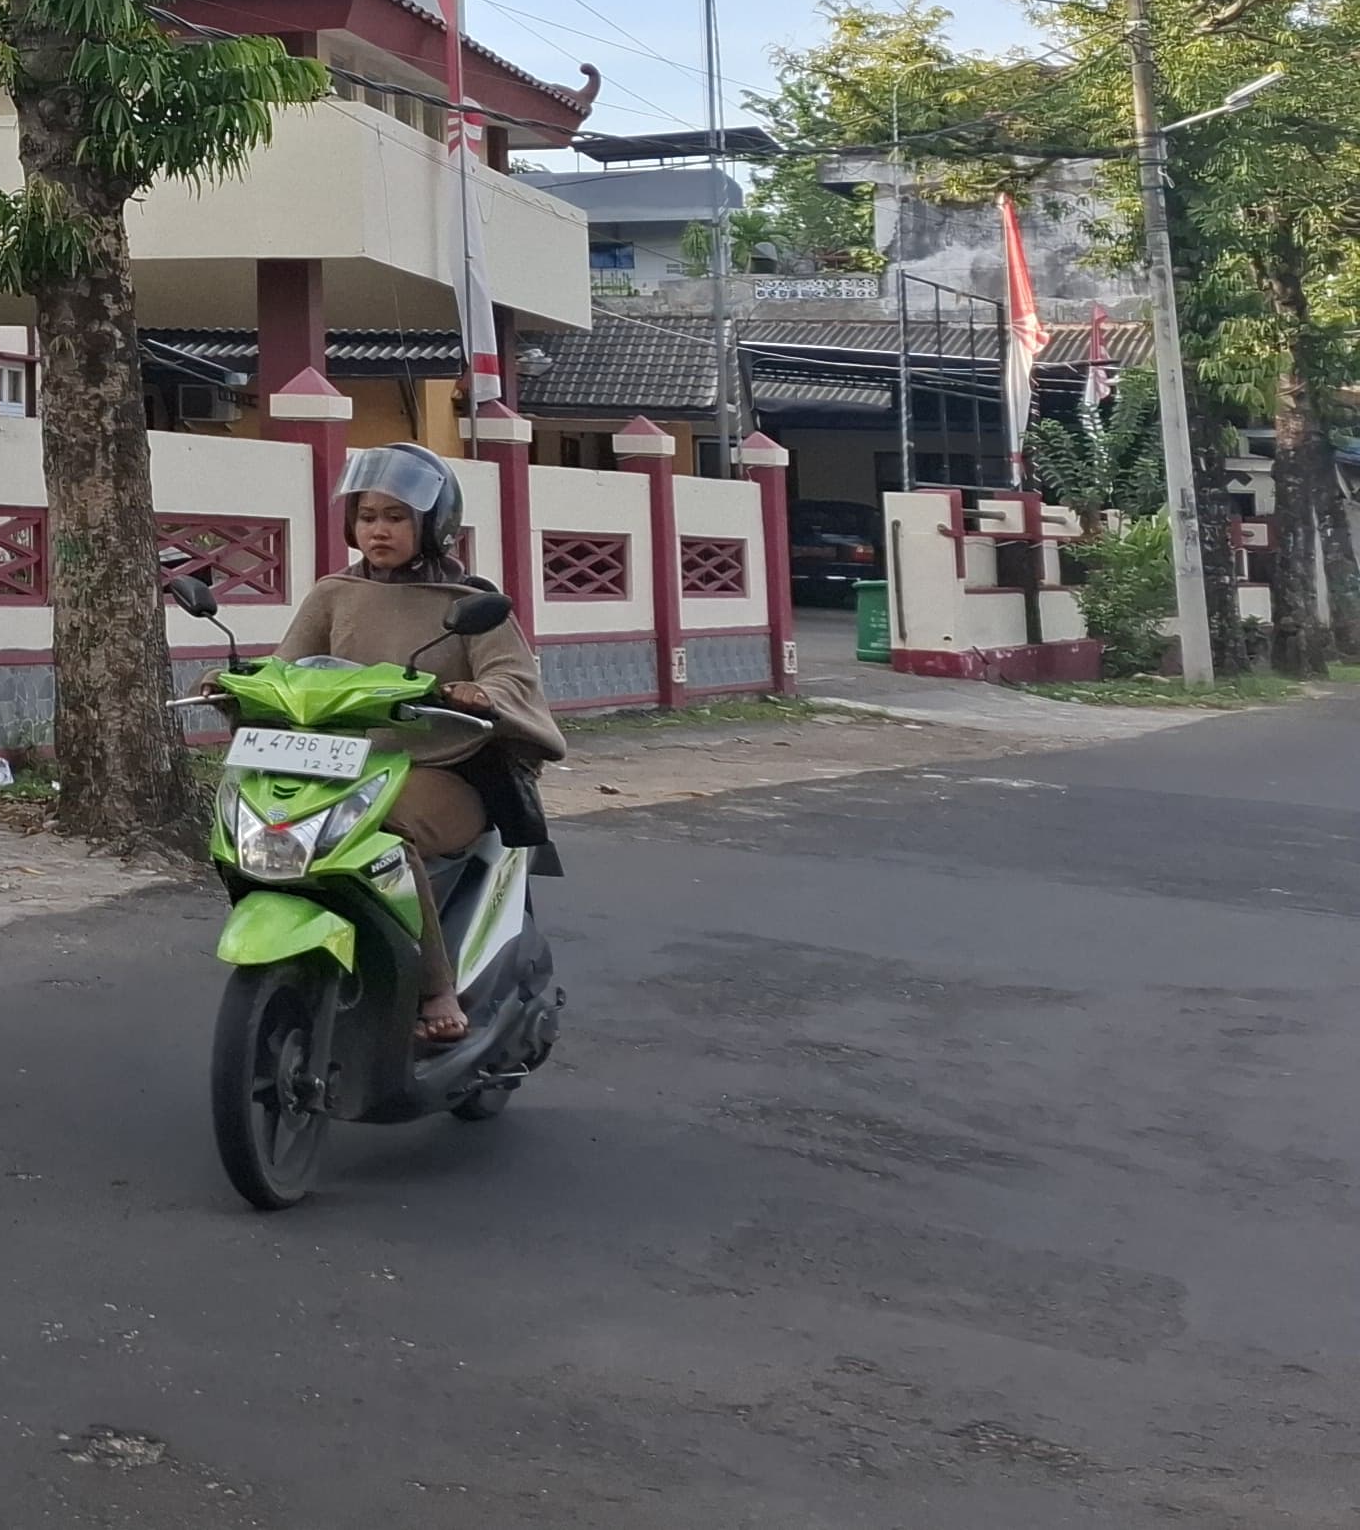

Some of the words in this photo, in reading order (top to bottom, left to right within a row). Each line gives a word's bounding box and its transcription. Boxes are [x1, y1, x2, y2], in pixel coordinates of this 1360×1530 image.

[243, 731, 259, 747] M
[269, 733, 321, 752] 4796
[329, 739, 358, 756] WC
